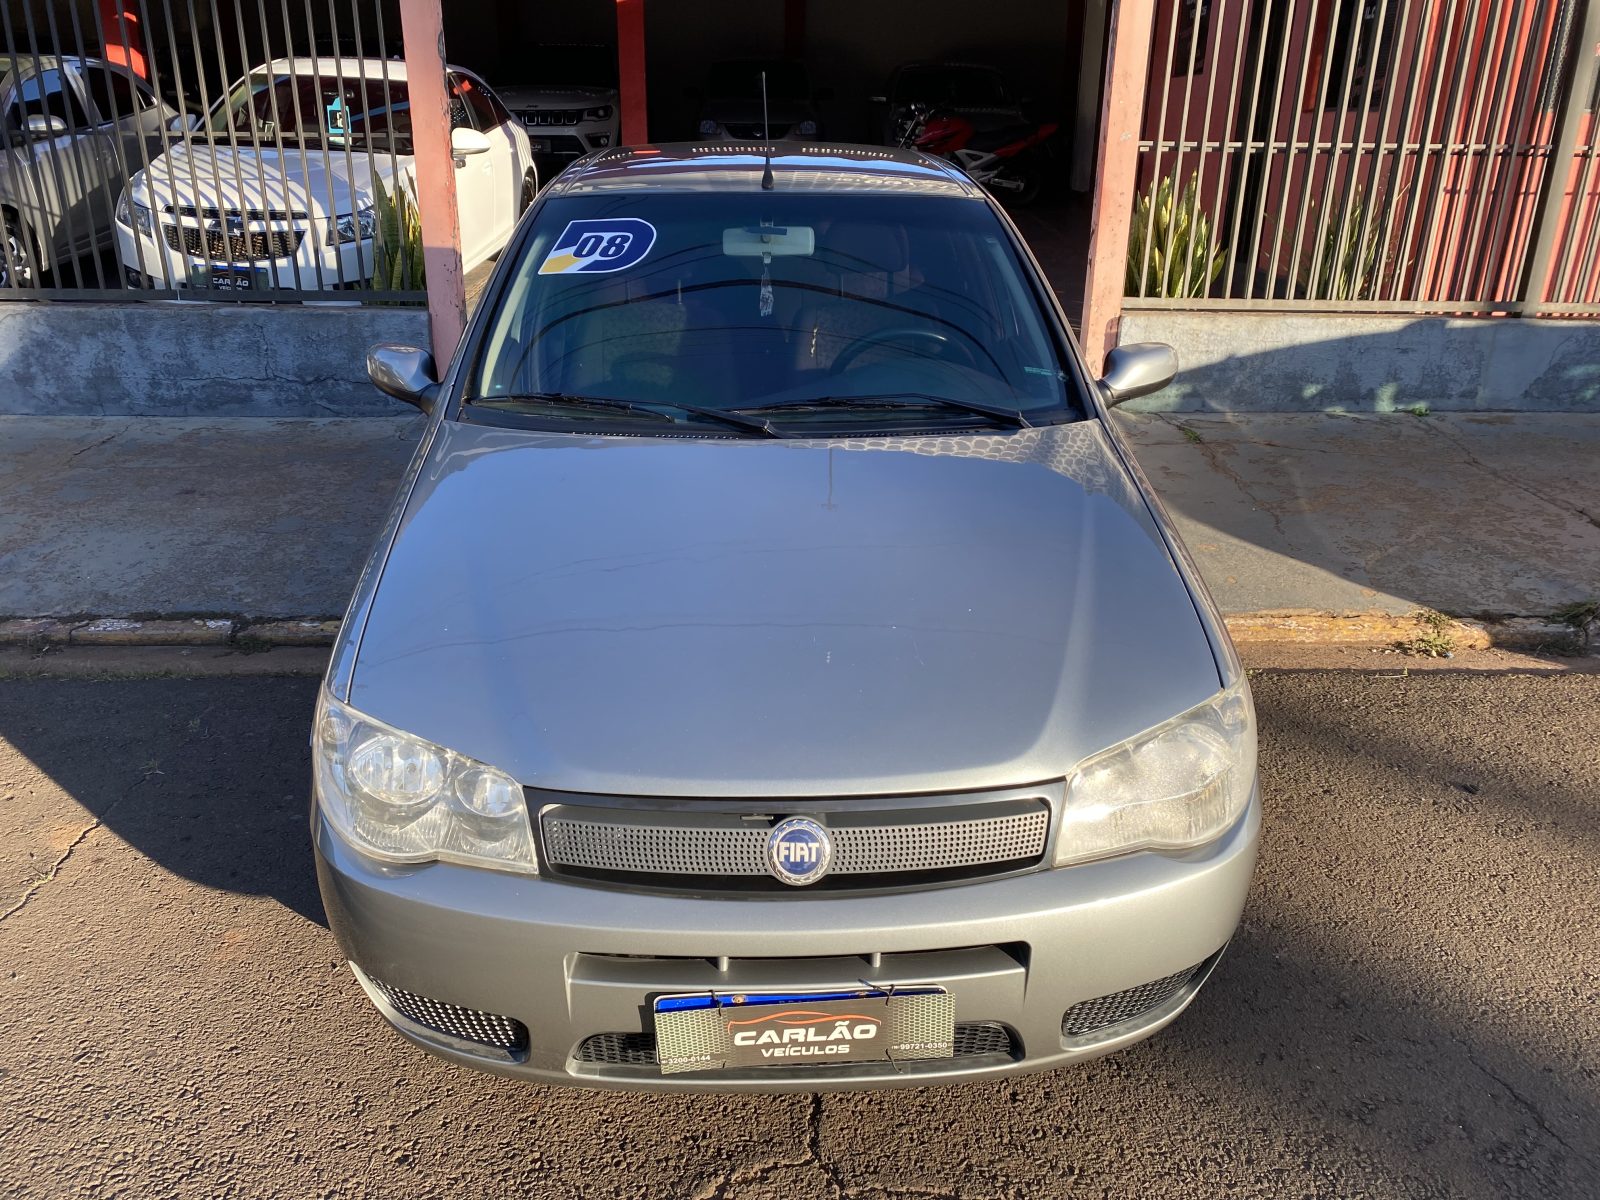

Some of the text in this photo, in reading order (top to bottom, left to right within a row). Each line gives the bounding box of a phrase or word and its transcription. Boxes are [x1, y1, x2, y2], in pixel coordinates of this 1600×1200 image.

[572, 234, 632, 259] 08
[212, 277, 249, 287] CARÃO
[779, 841, 820, 863] FIAT
[733, 1020, 878, 1047] CARLÃO
[760, 1044, 850, 1058] VEÍCULOS
